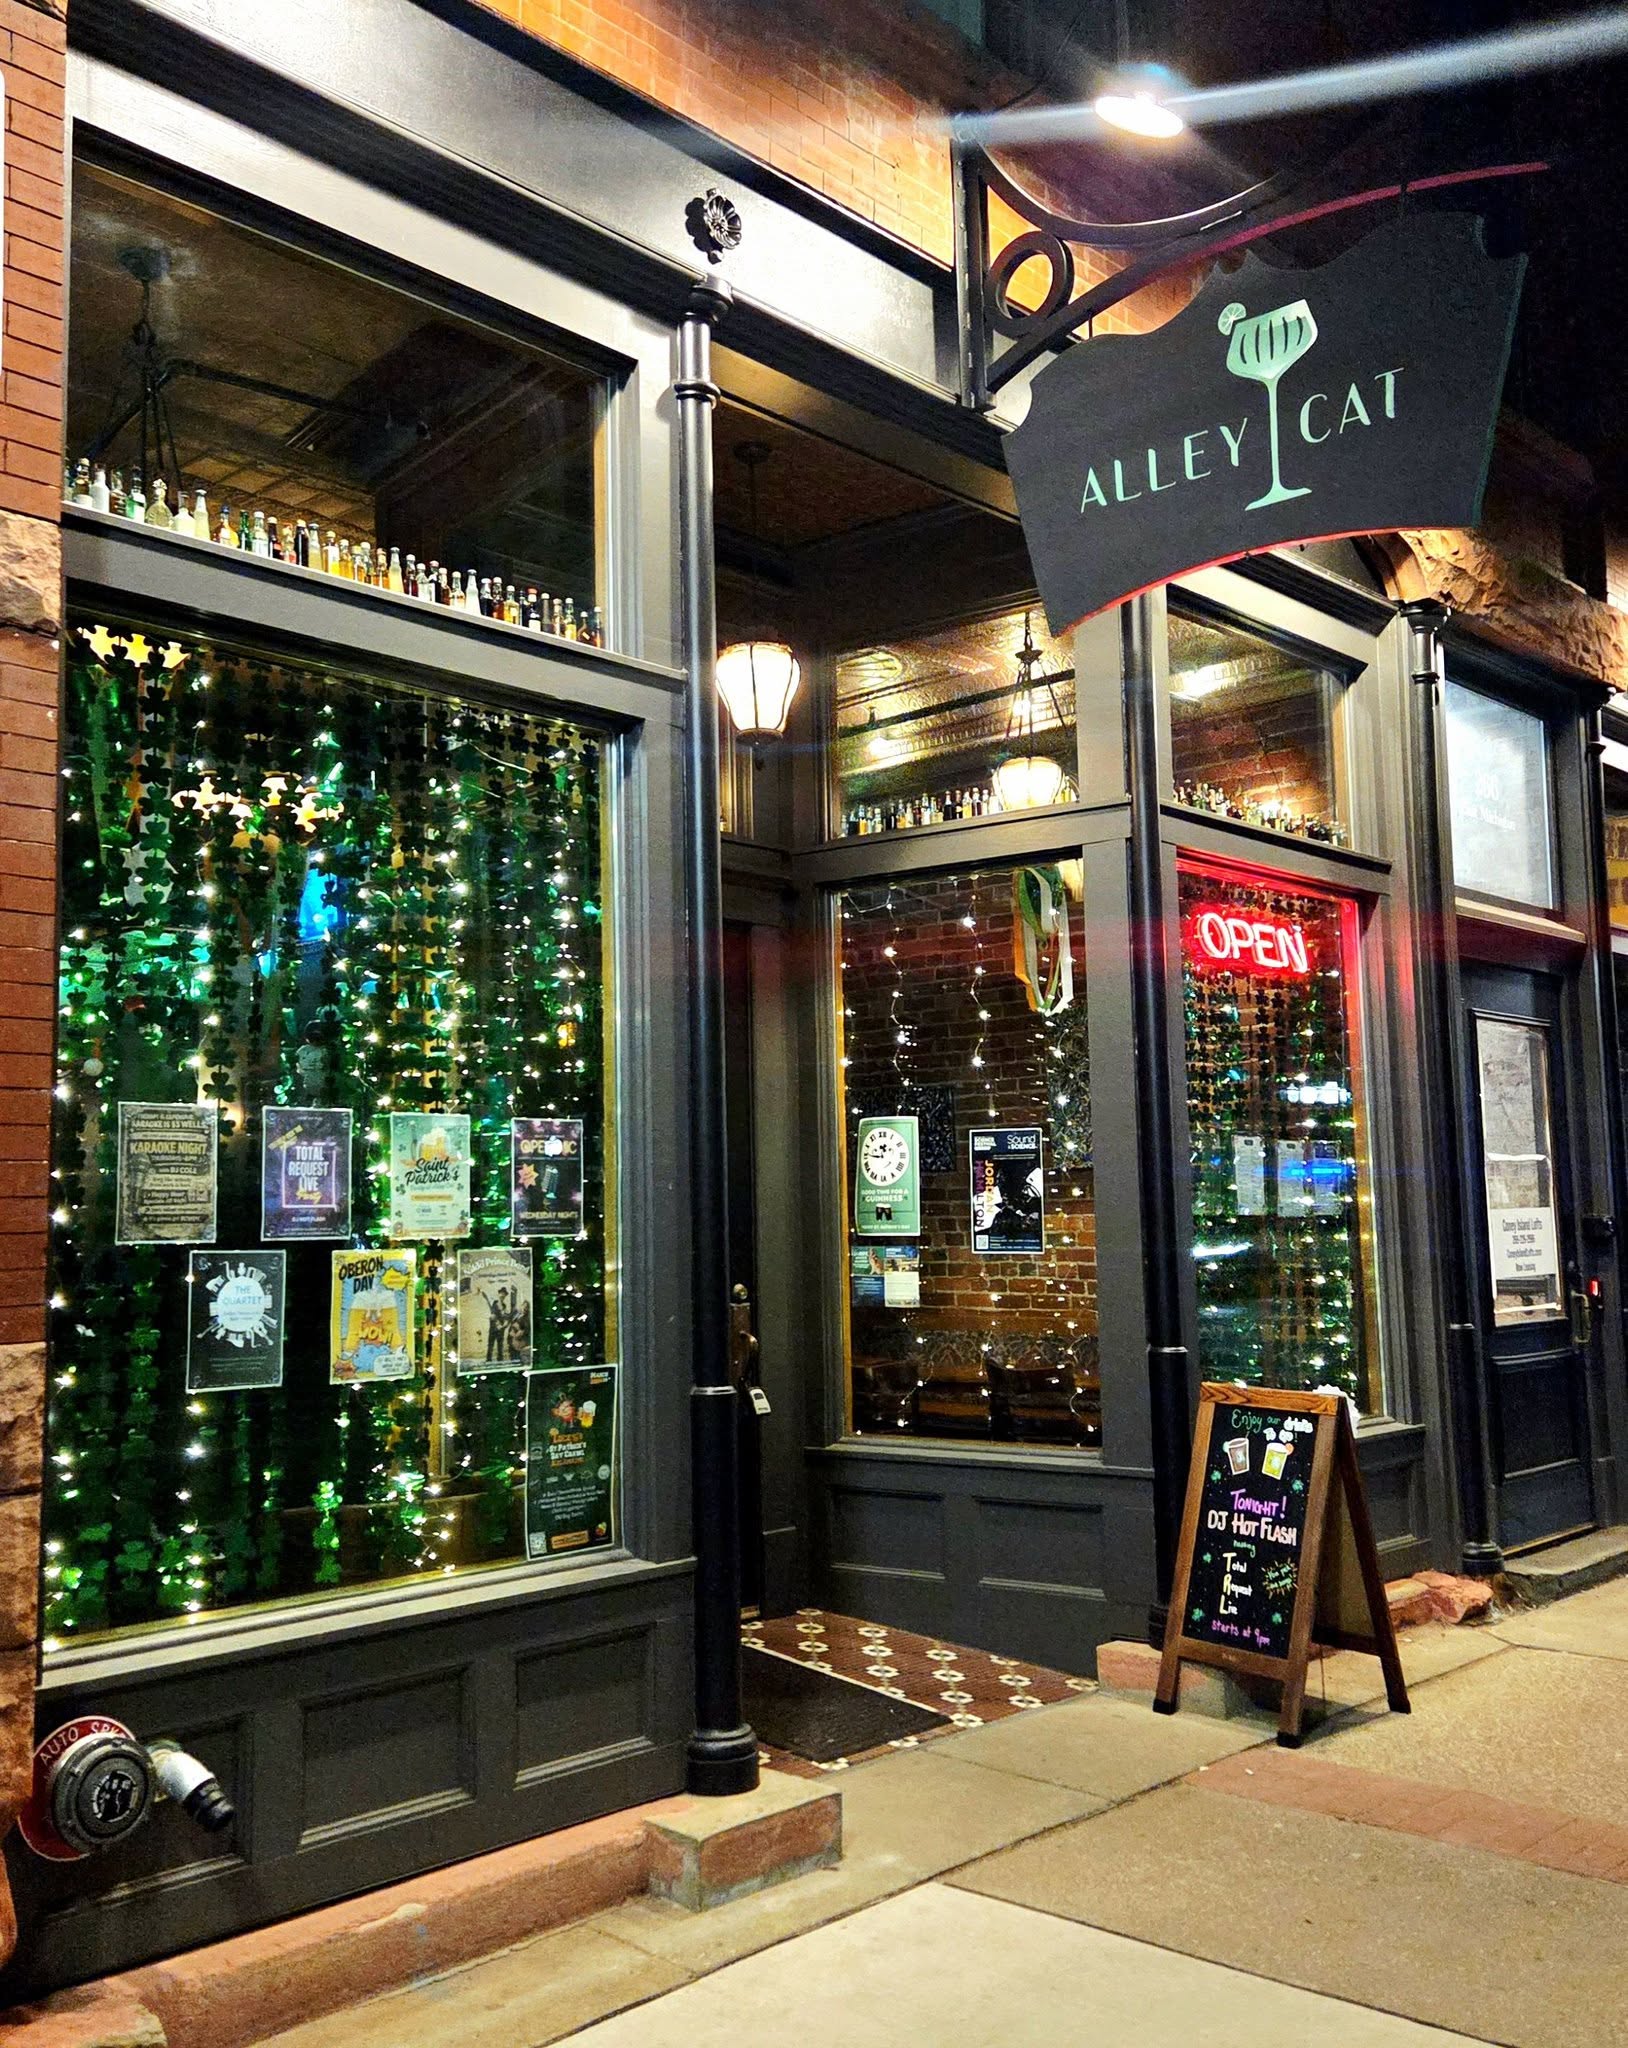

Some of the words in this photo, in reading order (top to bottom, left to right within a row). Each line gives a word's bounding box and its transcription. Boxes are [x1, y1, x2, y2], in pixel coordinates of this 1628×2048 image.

[1080, 418, 1248, 514] ALLEY
[1300, 367, 1404, 444] CAT
[1200, 912, 1309, 974] OPEN
[129, 1141, 177, 1154] KARAOKE
[177, 1141, 207, 1155] NIGHT
[1007, 1133, 1037, 1145] Sound
[296, 1145, 325, 1161] TOTAL
[288, 1161, 330, 1176] REQUEST
[415, 1157, 450, 1174] Saint
[299, 1176, 319, 1191] LIVE
[404, 1166, 461, 1186] Patrick's
[975, 1160, 985, 1228] HAMILTON
[985, 1160, 995, 1213] JORDAN
[864, 1194, 904, 1202] GUINNESS
[338, 1256, 384, 1281] OBERON
[234, 1285, 251, 1294] THE
[353, 1274, 375, 1294] DAY
[222, 1296, 263, 1305] QUARTET
[1231, 1408, 1263, 1434] Enjoy
[1267, 1415, 1281, 1424] our
[1207, 1509, 1229, 1531] DJ
[1222, 1552, 1247, 1573] Total
[1222, 1573, 1253, 1598] Request
[1211, 1619, 1240, 1637] starts
[1242, 1625, 1252, 1638] at
[1254, 1627, 1270, 1649] 9pm
[40, 1726, 79, 1767] AUTO
